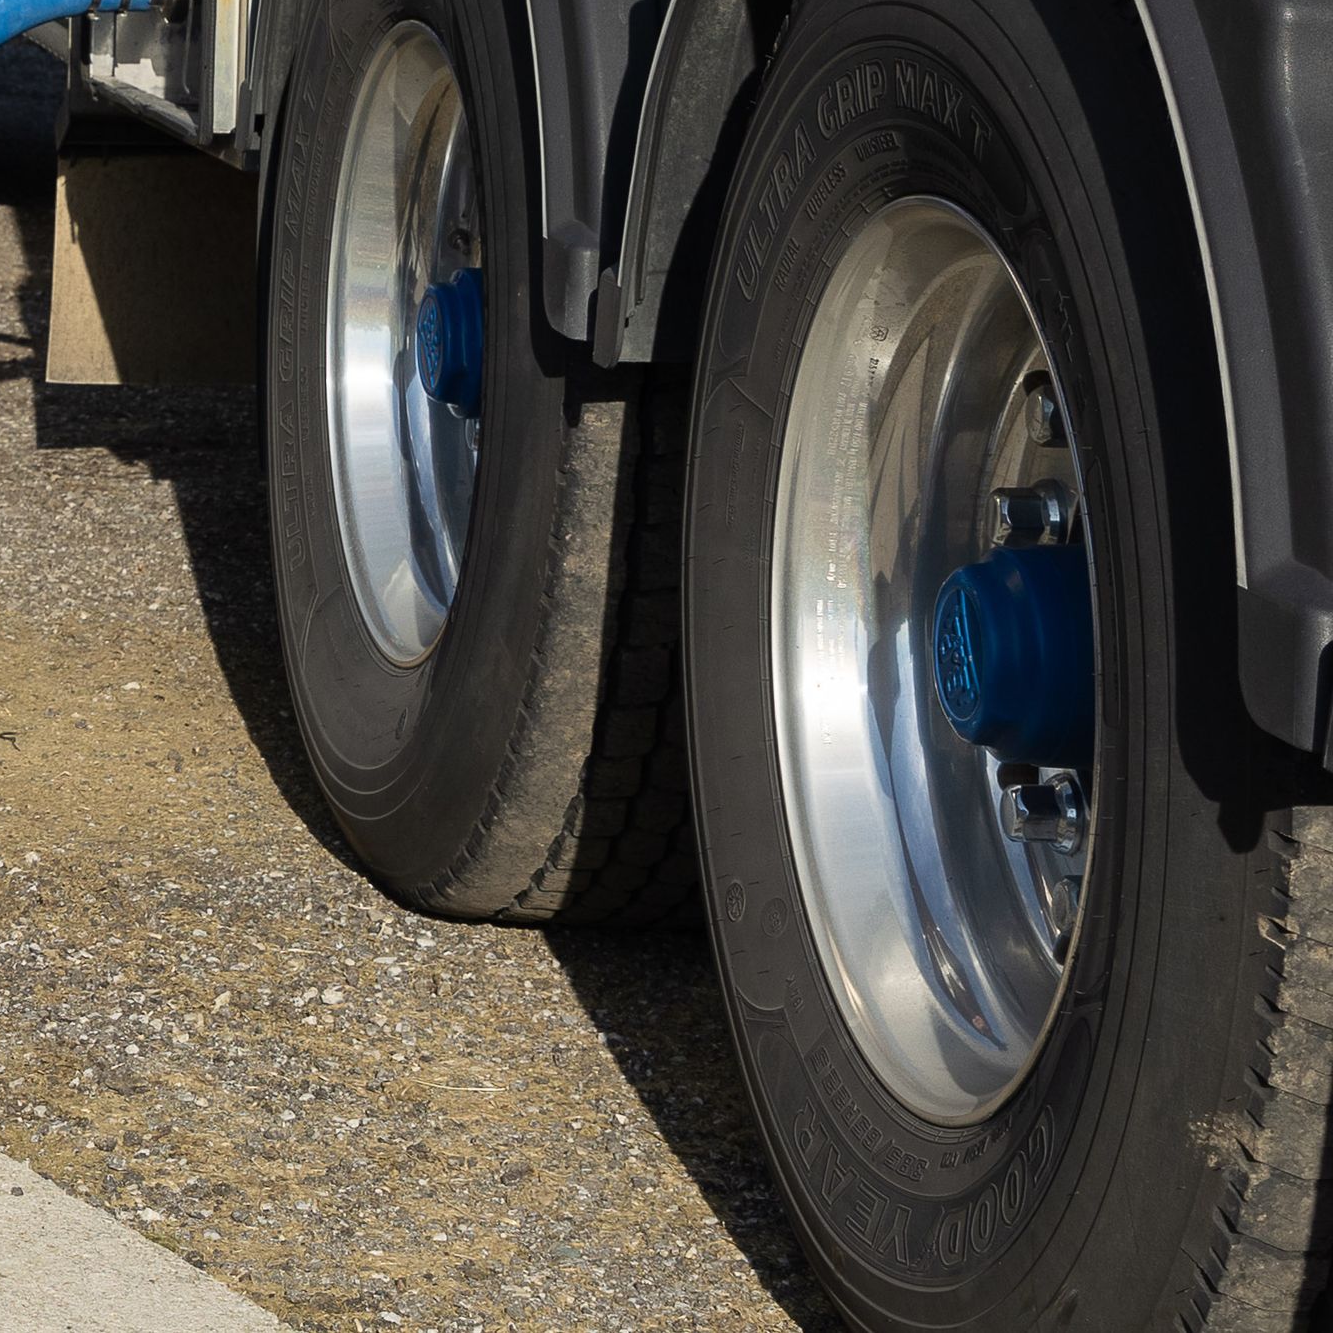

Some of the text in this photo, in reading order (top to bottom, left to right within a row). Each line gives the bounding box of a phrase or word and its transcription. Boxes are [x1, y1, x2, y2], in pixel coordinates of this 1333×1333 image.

[284, 113, 312, 239] MAX
[736, 119, 818, 302] ULTRA
[807, 57, 886, 141] GRIP
[895, 57, 963, 140] MAX
[774, 237, 801, 292] RADIAL
[805, 160, 848, 220] TUBELESS
[277, 246, 295, 384] GRIP
[279, 400, 307, 573] ULTRA
